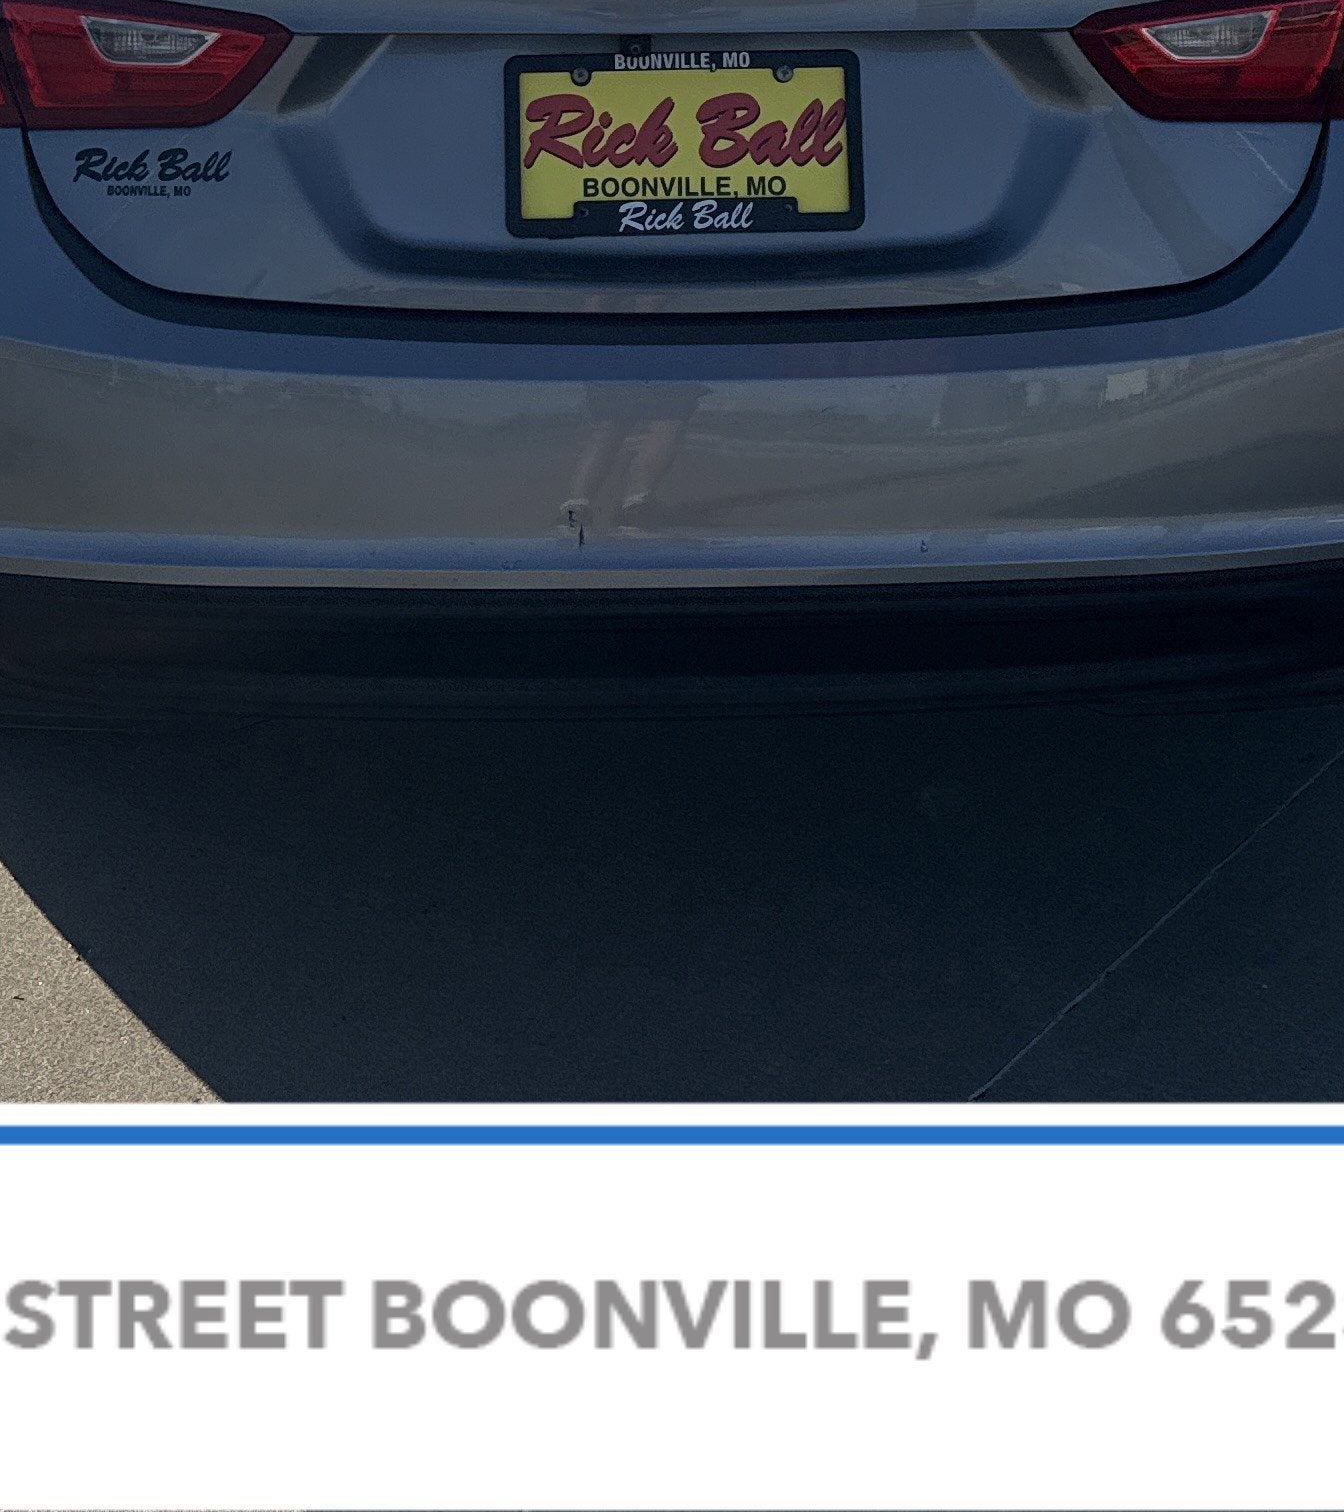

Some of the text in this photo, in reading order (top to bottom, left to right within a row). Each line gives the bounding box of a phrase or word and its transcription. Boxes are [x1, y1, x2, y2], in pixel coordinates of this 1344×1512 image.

[722, 51, 751, 68] MO
[523, 92, 847, 169] Rick Ball
[72, 147, 233, 183] Rick Ball
[106, 185, 192, 198] BOONVILLE, MO
[583, 175, 787, 198] BOONVILLE, MO
[618, 201, 754, 233] Rick Ball
